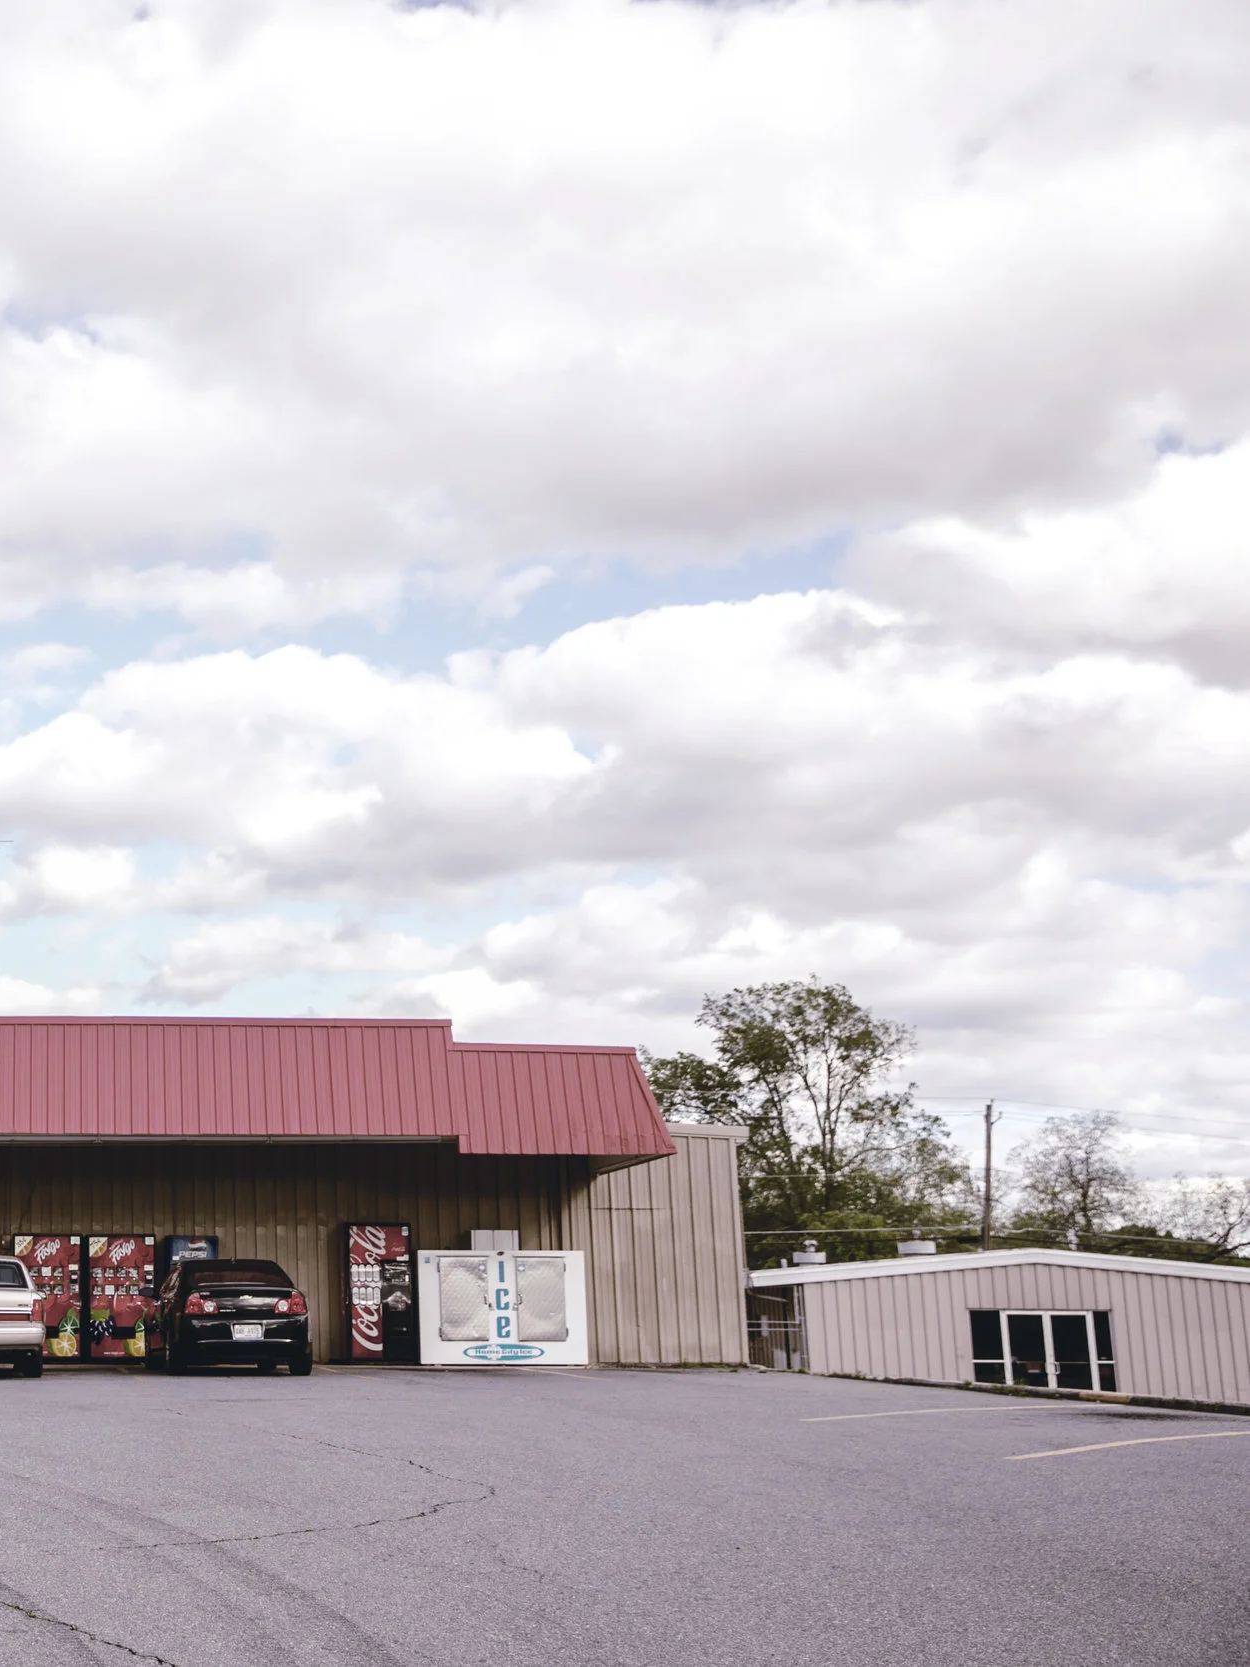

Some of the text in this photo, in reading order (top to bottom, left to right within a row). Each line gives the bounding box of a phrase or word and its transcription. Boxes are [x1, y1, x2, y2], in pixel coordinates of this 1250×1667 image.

[34, 1239, 61, 1265] Faygo
[109, 1239, 136, 1266] Faygo
[179, 1250, 207, 1258] PEPSI
